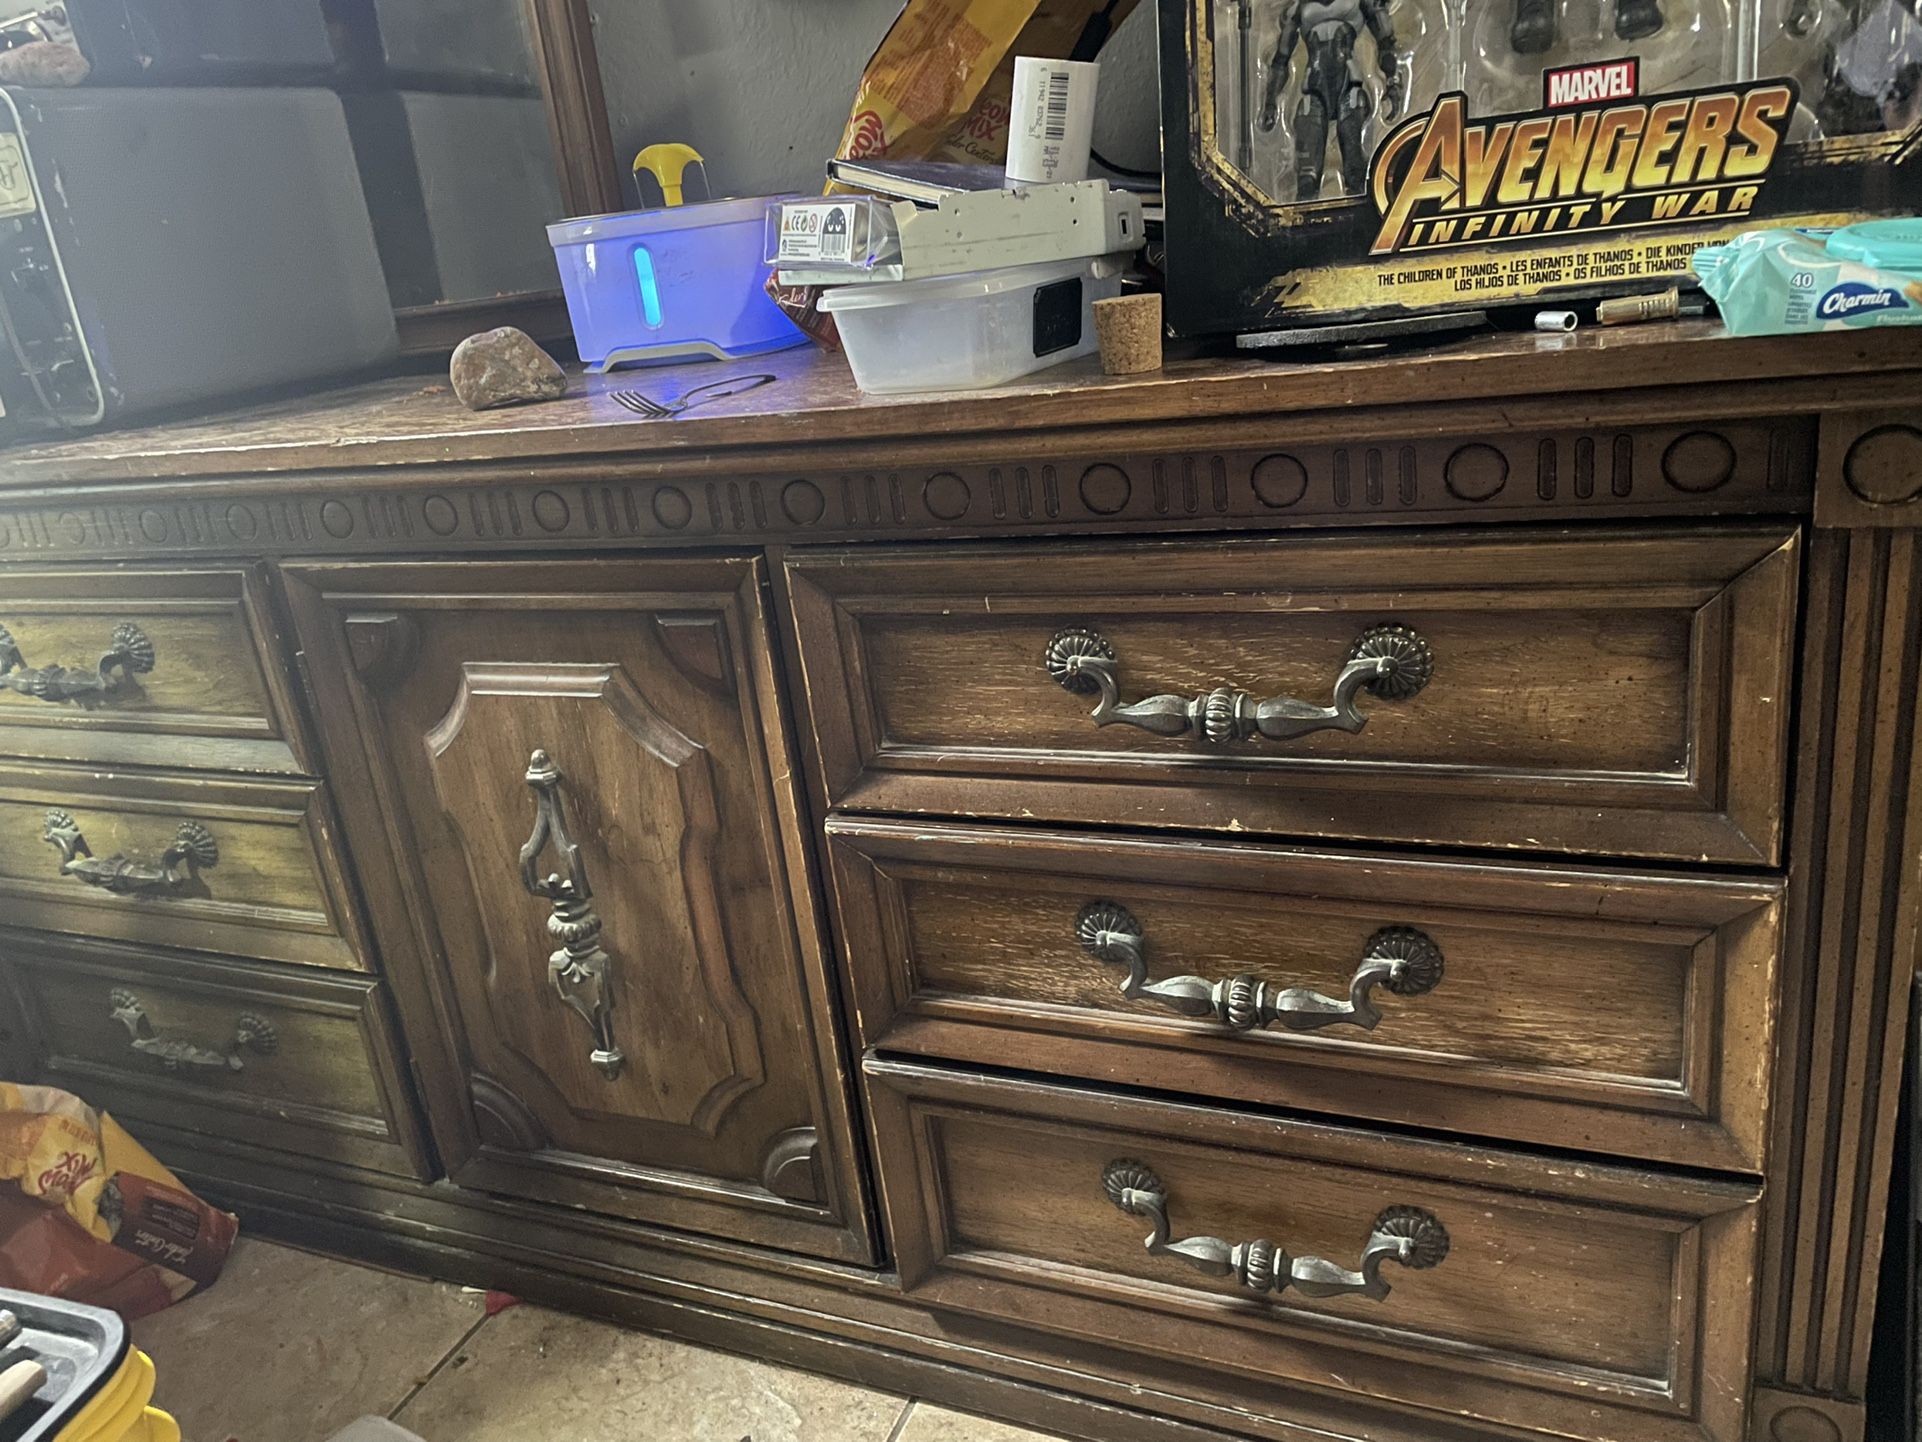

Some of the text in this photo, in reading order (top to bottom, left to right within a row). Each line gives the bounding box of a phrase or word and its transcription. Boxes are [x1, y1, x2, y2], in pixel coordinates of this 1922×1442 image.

[1550, 65, 1632, 105] MARVEL
[1367, 85, 1791, 255] AVENGERS
[1408, 185, 1759, 246] INFINITY WAR
[1378, 273, 1395, 286] THE
[1398, 268, 1443, 285] CHILDREN
[1446, 266, 1458, 279] OF
[1461, 263, 1499, 278] THANOS
[1510, 260, 1527, 273] LES
[1530, 253, 1574, 271] ENFANTS
[1576, 252, 1590, 266] DE
[1593, 249, 1634, 264] THANOS
[1645, 246, 1662, 259] DIE
[1454, 257, 1687, 291] LOS HIJOS DE THANOS OS FILHOS DE THANOS
[1791, 272, 1814, 289] 40
[1823, 289, 1892, 314] Charmin
